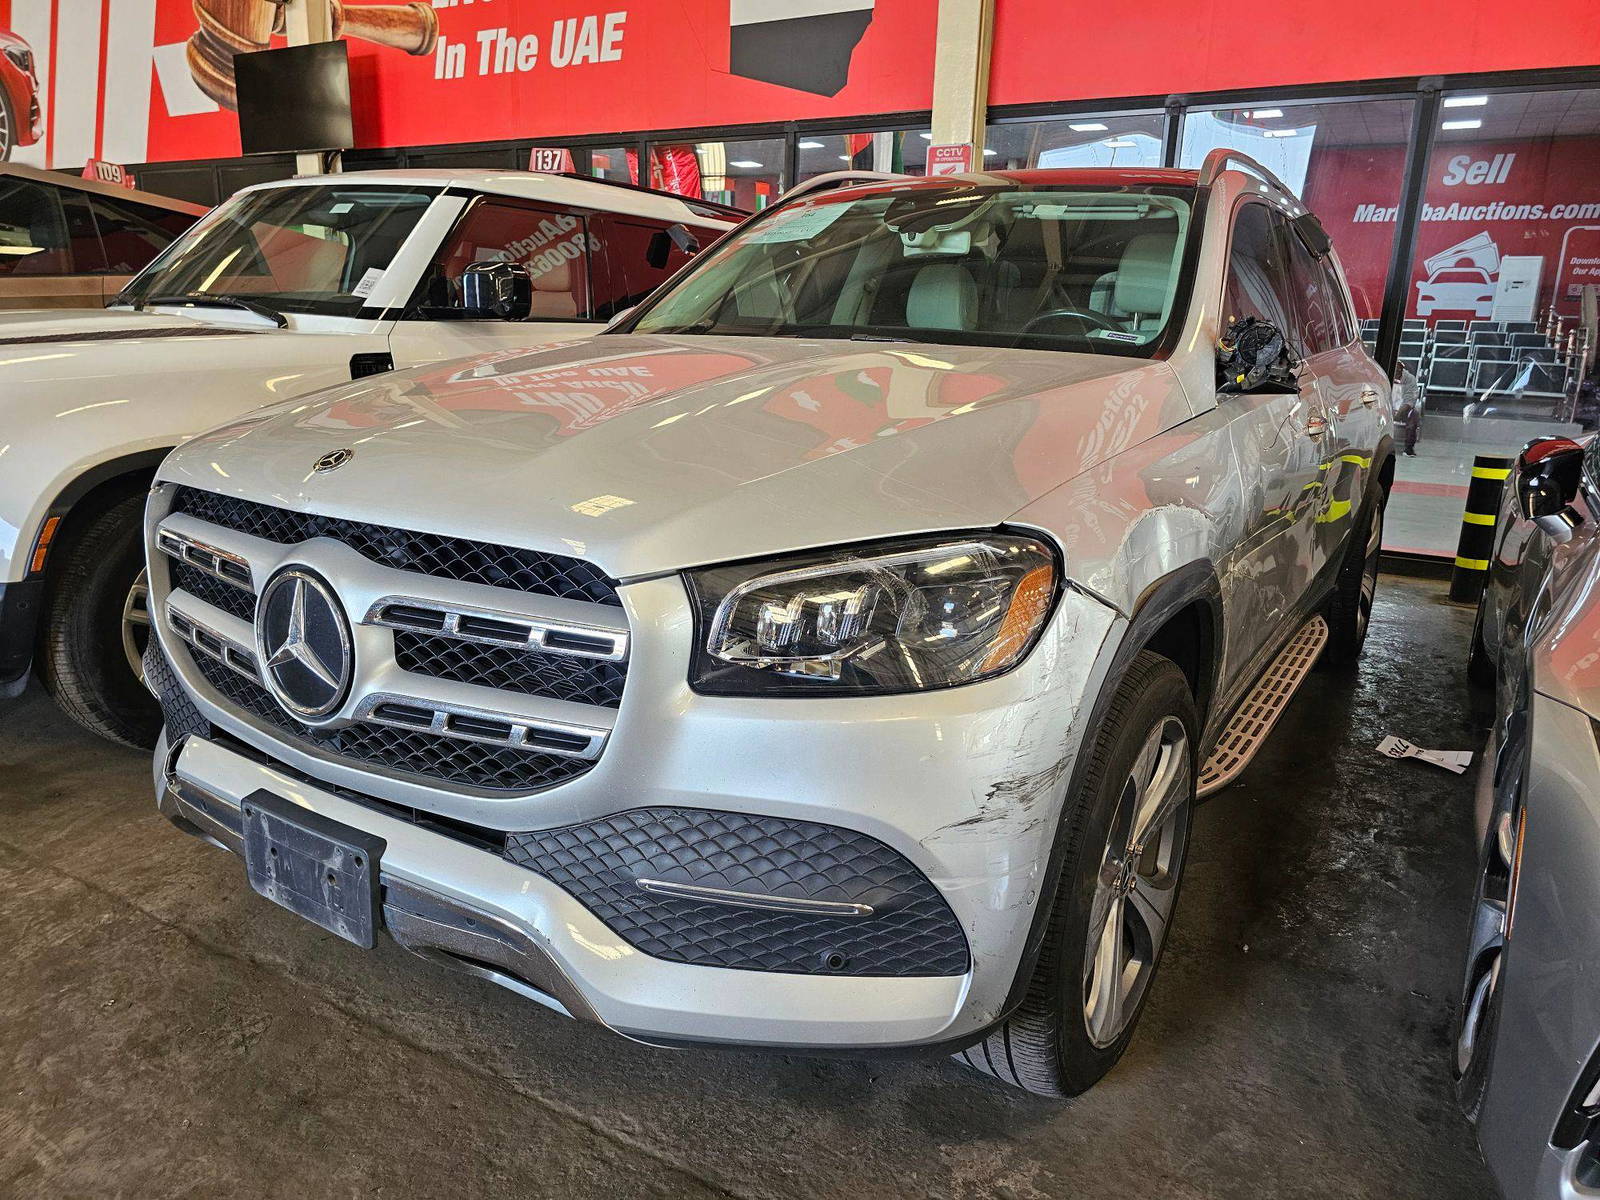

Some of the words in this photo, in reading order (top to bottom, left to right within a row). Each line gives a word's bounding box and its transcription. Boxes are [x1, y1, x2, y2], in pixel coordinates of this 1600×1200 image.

[434, 36, 466, 79] In
[476, 27, 539, 76] The
[550, 11, 627, 68] UAE
[536, 150, 561, 170] 137
[937, 148, 964, 157] CCTV
[96, 162, 122, 183] 109
[1442, 153, 1516, 186] Sell
[1572, 267, 1588, 275] Our
